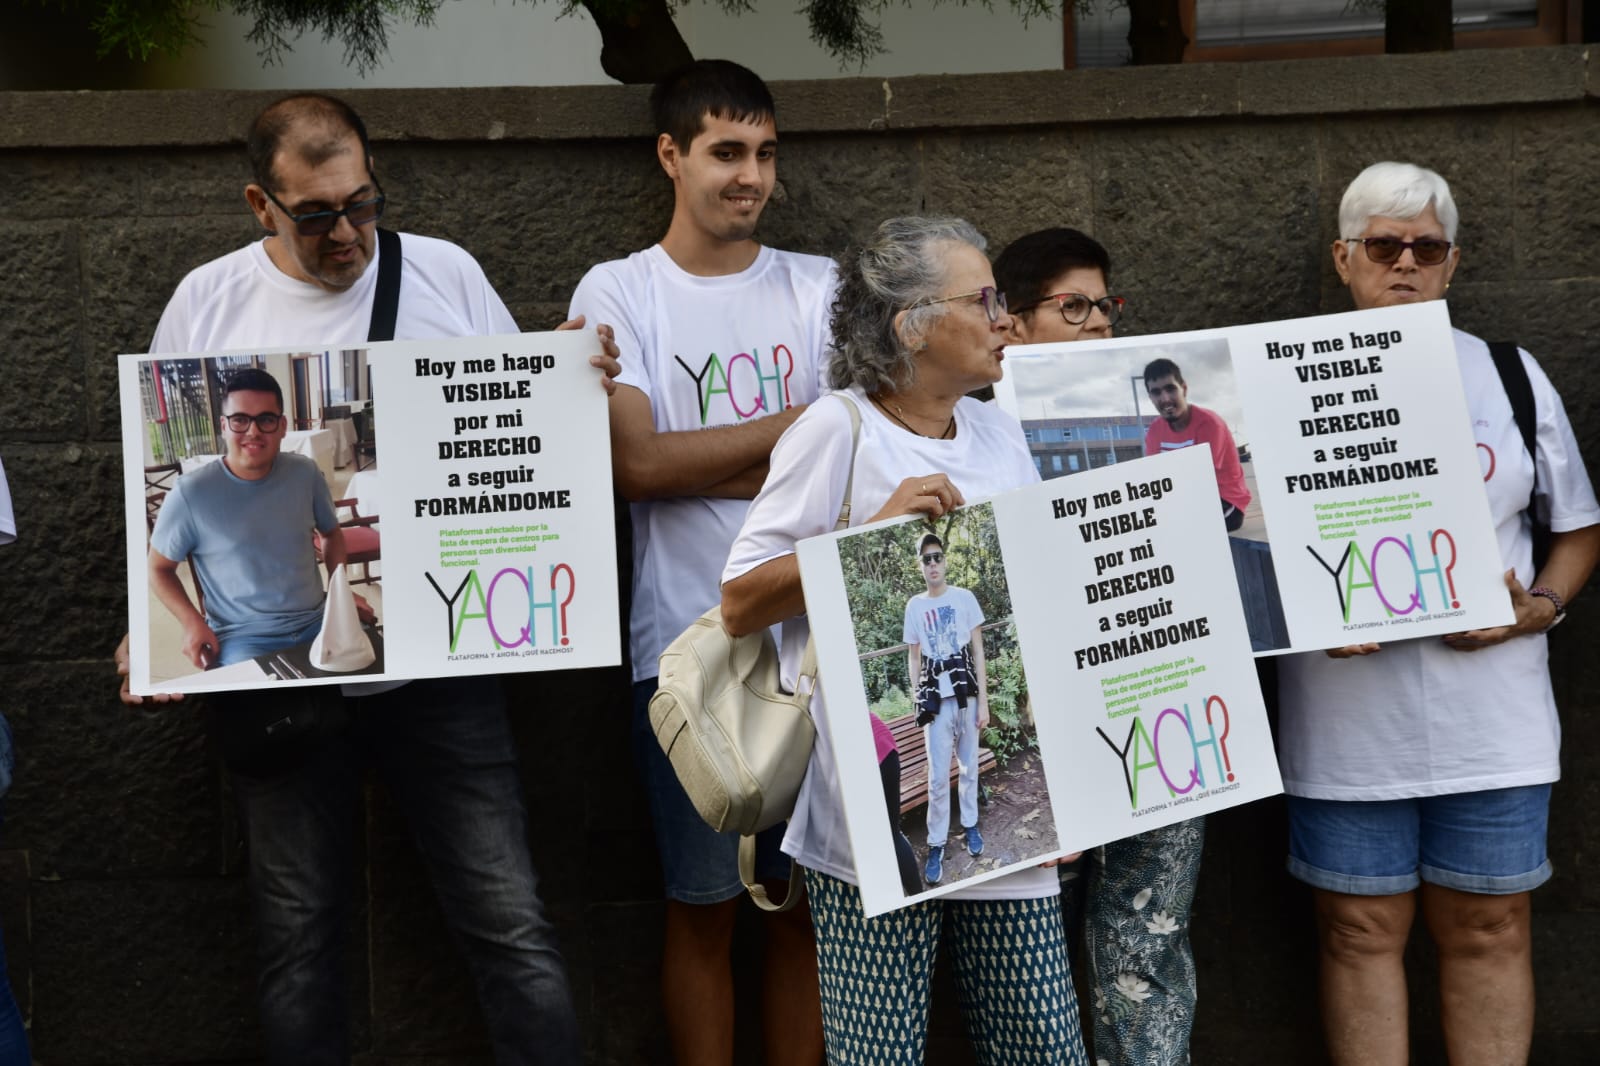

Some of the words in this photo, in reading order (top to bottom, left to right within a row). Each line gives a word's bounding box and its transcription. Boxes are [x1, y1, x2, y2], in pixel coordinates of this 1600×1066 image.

[1266, 342, 1304, 360] Hoy
[1312, 337, 1344, 354] me
[1350, 330, 1402, 350] hago
[415, 358, 455, 379] Hoy
[463, 358, 495, 374] me
[502, 354, 555, 374] hago
[1295, 356, 1383, 383] VISIBLE
[442, 380, 531, 402] VISIBLE
[675, 344, 793, 425] YAQH?
[1311, 392, 1344, 412] por
[1352, 384, 1379, 403] mi
[454, 415, 488, 435] por
[496, 409, 523, 428] mi
[1299, 408, 1400, 437] DERECHO
[438, 436, 541, 459] DERECHO
[1314, 449, 1326, 462] a
[1333, 437, 1398, 461] seguir
[448, 473, 460, 487] a
[468, 465, 534, 489] seguir
[1285, 458, 1438, 493] FORMÁNDOME
[415, 490, 570, 517] FORMÁNDOME
[1052, 497, 1087, 519] Hoy
[1093, 490, 1122, 509] me
[1126, 478, 1173, 500] hago
[485, 525, 523, 534] afectados
[526, 525, 539, 533] por
[1079, 507, 1157, 543] VISIBLE
[440, 549, 476, 558] personas
[496, 544, 536, 553] diversidad
[471, 538, 497, 546] espera
[542, 534, 559, 542] para
[1094, 551, 1123, 576] por
[1130, 539, 1154, 562] mi
[1085, 565, 1174, 604] DERECHO
[1306, 529, 1460, 623] YAQH?
[425, 563, 575, 653] YAQH?
[1099, 617, 1111, 632] a
[1116, 597, 1173, 628] seguir
[1074, 617, 1210, 670] FORMÁNDOME
[1096, 695, 1234, 809] YAQH?
